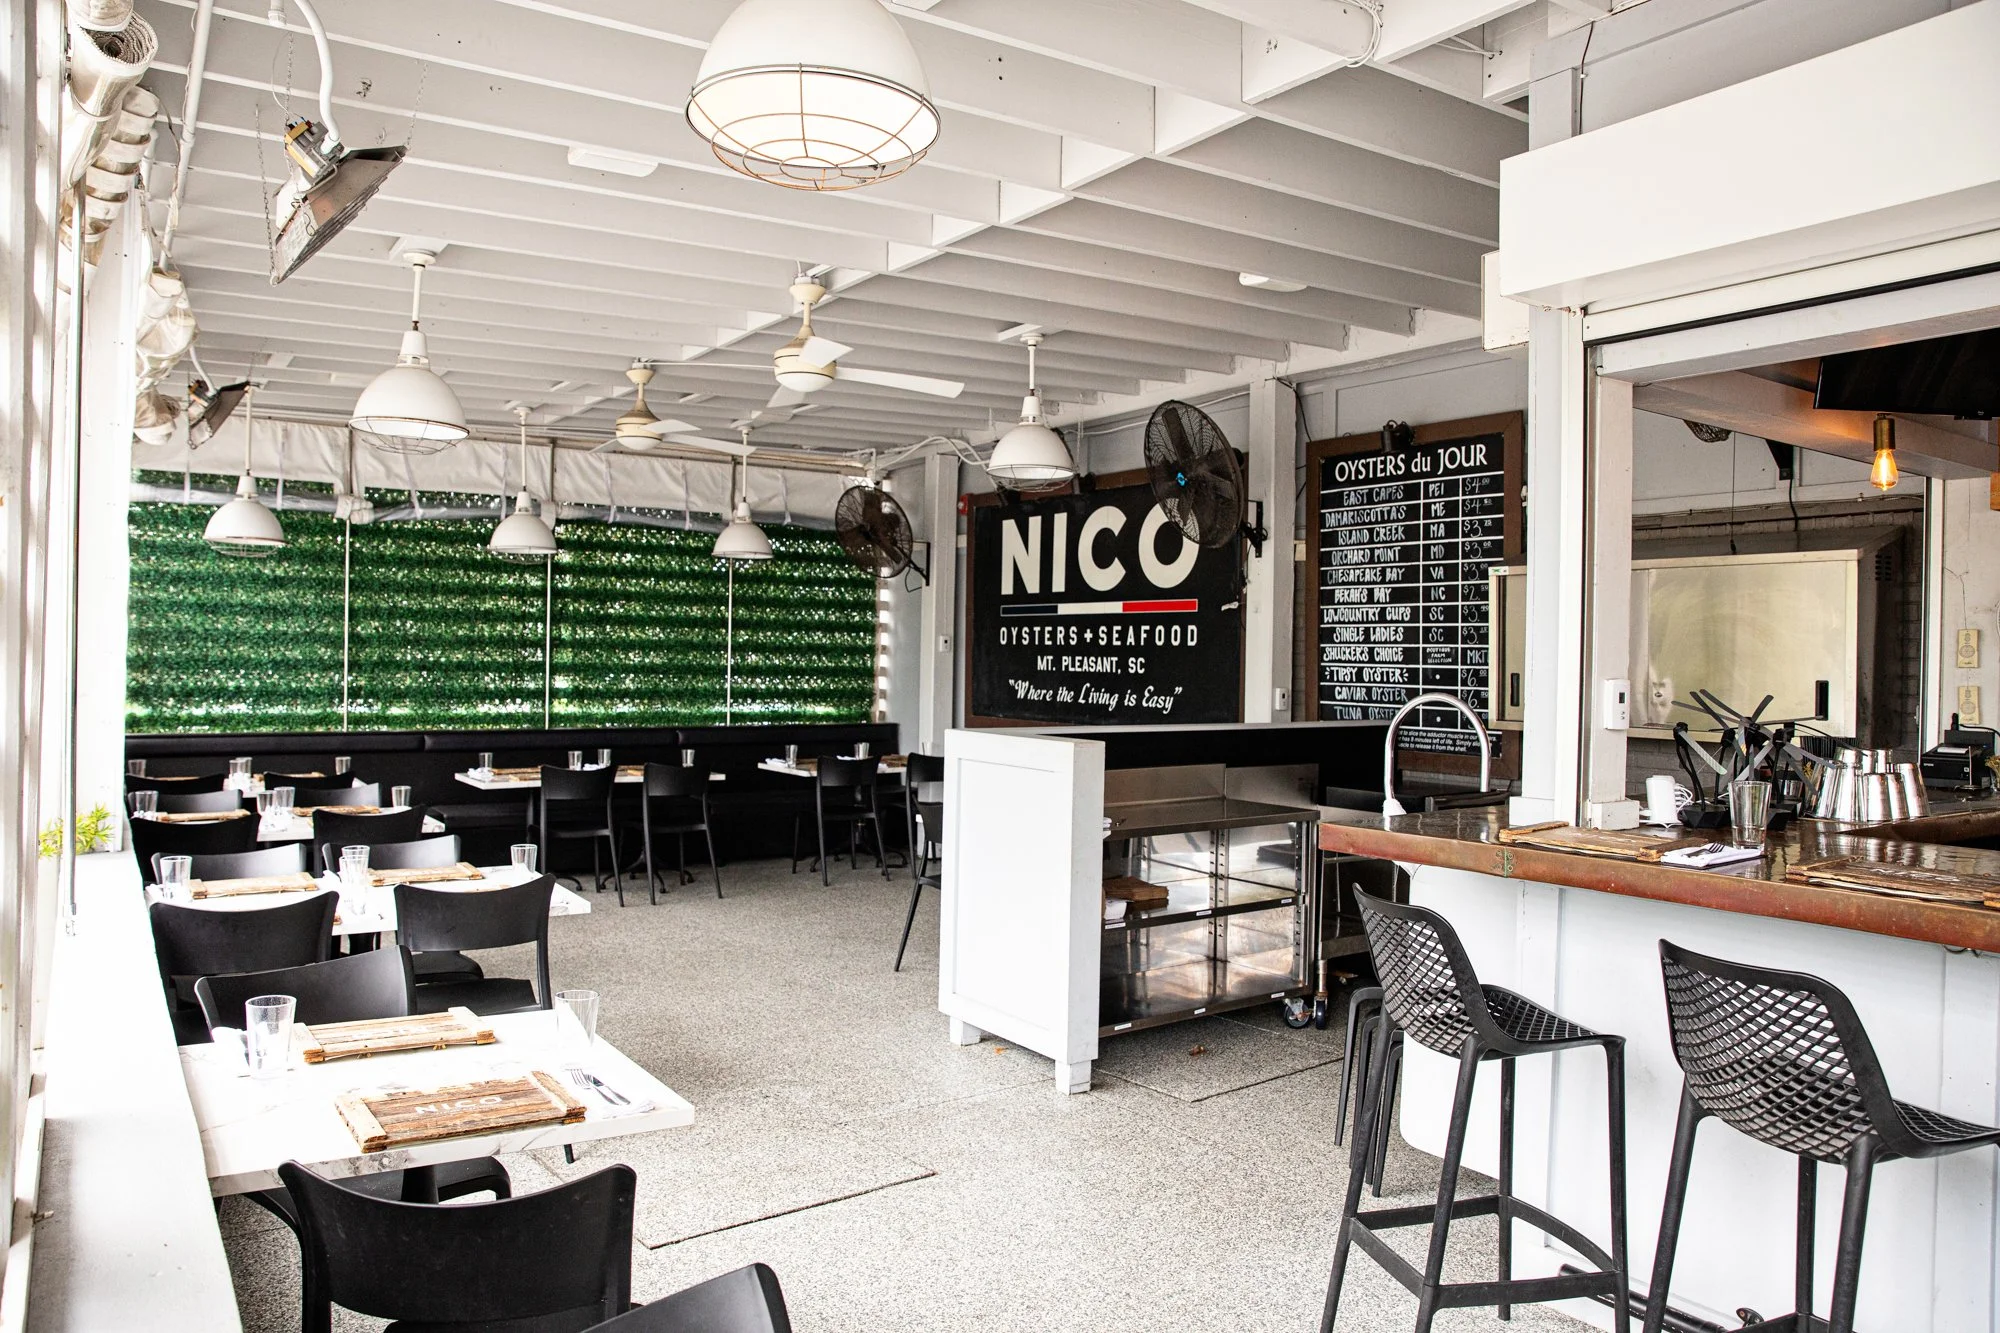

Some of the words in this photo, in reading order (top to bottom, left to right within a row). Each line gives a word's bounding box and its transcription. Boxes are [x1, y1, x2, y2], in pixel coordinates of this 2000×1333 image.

[1334, 453, 1406, 482] OYSTERS
[1411, 452, 1431, 473] du
[1437, 444, 1488, 475] JOUR
[1343, 489, 1369, 506] EAST
[1372, 485, 1404, 502] CAPES
[1428, 482, 1444, 497] PEI
[1325, 505, 1407, 528] DAMARISCOTTA'S
[1430, 502, 1446, 517] ME
[1338, 529, 1370, 546] ISLAND
[1373, 525, 1405, 542] CREEK
[1429, 523, 1445, 538] MA
[1001, 497, 1199, 595] NICO
[1331, 548, 1371, 566] ORCHARD
[1374, 546, 1401, 563] POINT
[1430, 544, 1445, 560] MD
[1327, 567, 1383, 585] CHESAPEAKE
[1385, 567, 1405, 582] BAY
[1429, 566, 1444, 580] VA
[1334, 588, 1368, 604] BEKAH'S
[1373, 587, 1392, 603] BAY
[1430, 587, 1446, 601] NC
[1323, 607, 1381, 623] LOWCOUNTRY
[1385, 606, 1411, 622] CUPS
[1429, 606, 1444, 621] SC
[1333, 627, 1365, 643] SINGLE
[1370, 626, 1404, 642] LADIES
[1428, 627, 1444, 642] SC
[1323, 646, 1369, 662] SHUCKER'S
[1373, 647, 1404, 662] CHOICE
[1037, 656, 1056, 671] MT.
[1061, 656, 1121, 675] PLEASANT,
[1128, 657, 1146, 674] SC
[1330, 666, 1358, 682] TIPSY
[1362, 667, 1403, 683] OYSTER
[1056, 686, 1075, 703] the
[1078, 682, 1119, 712] Living
[1124, 689, 1137, 707] is
[1334, 686, 1369, 701] CAVIAR
[1371, 687, 1409, 702] OYSTER
[1333, 706, 1363, 720] TUNA
[1368, 706, 1400, 721] OYSTE
[414, 1095, 503, 1115] NICO
